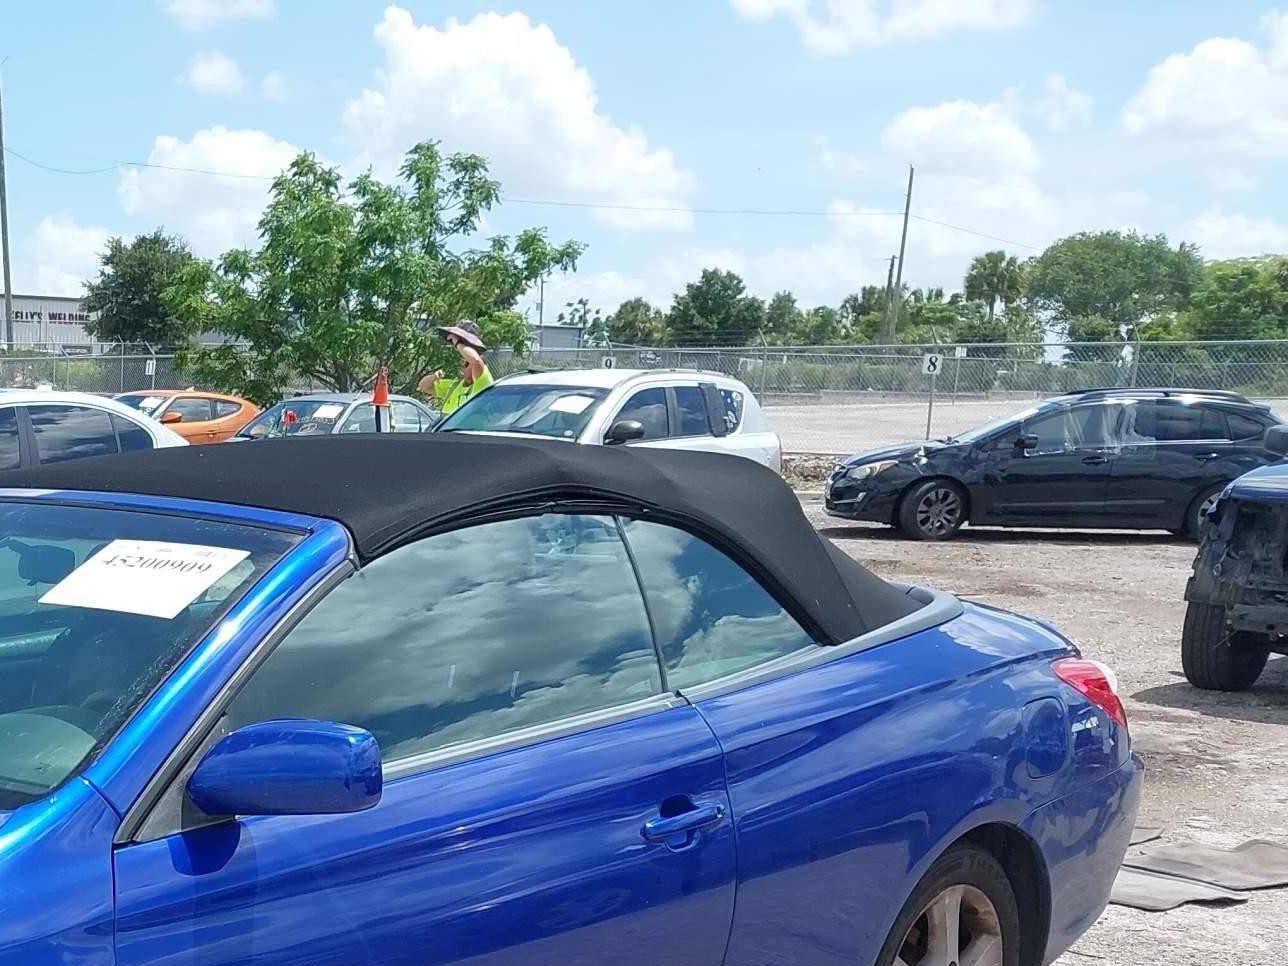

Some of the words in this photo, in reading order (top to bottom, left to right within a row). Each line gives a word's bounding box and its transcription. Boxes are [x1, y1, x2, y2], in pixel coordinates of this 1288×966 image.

[12, 310, 43, 322] ELLY'S
[927, 355, 938, 372] 8
[102, 554, 212, 573] 45200909
